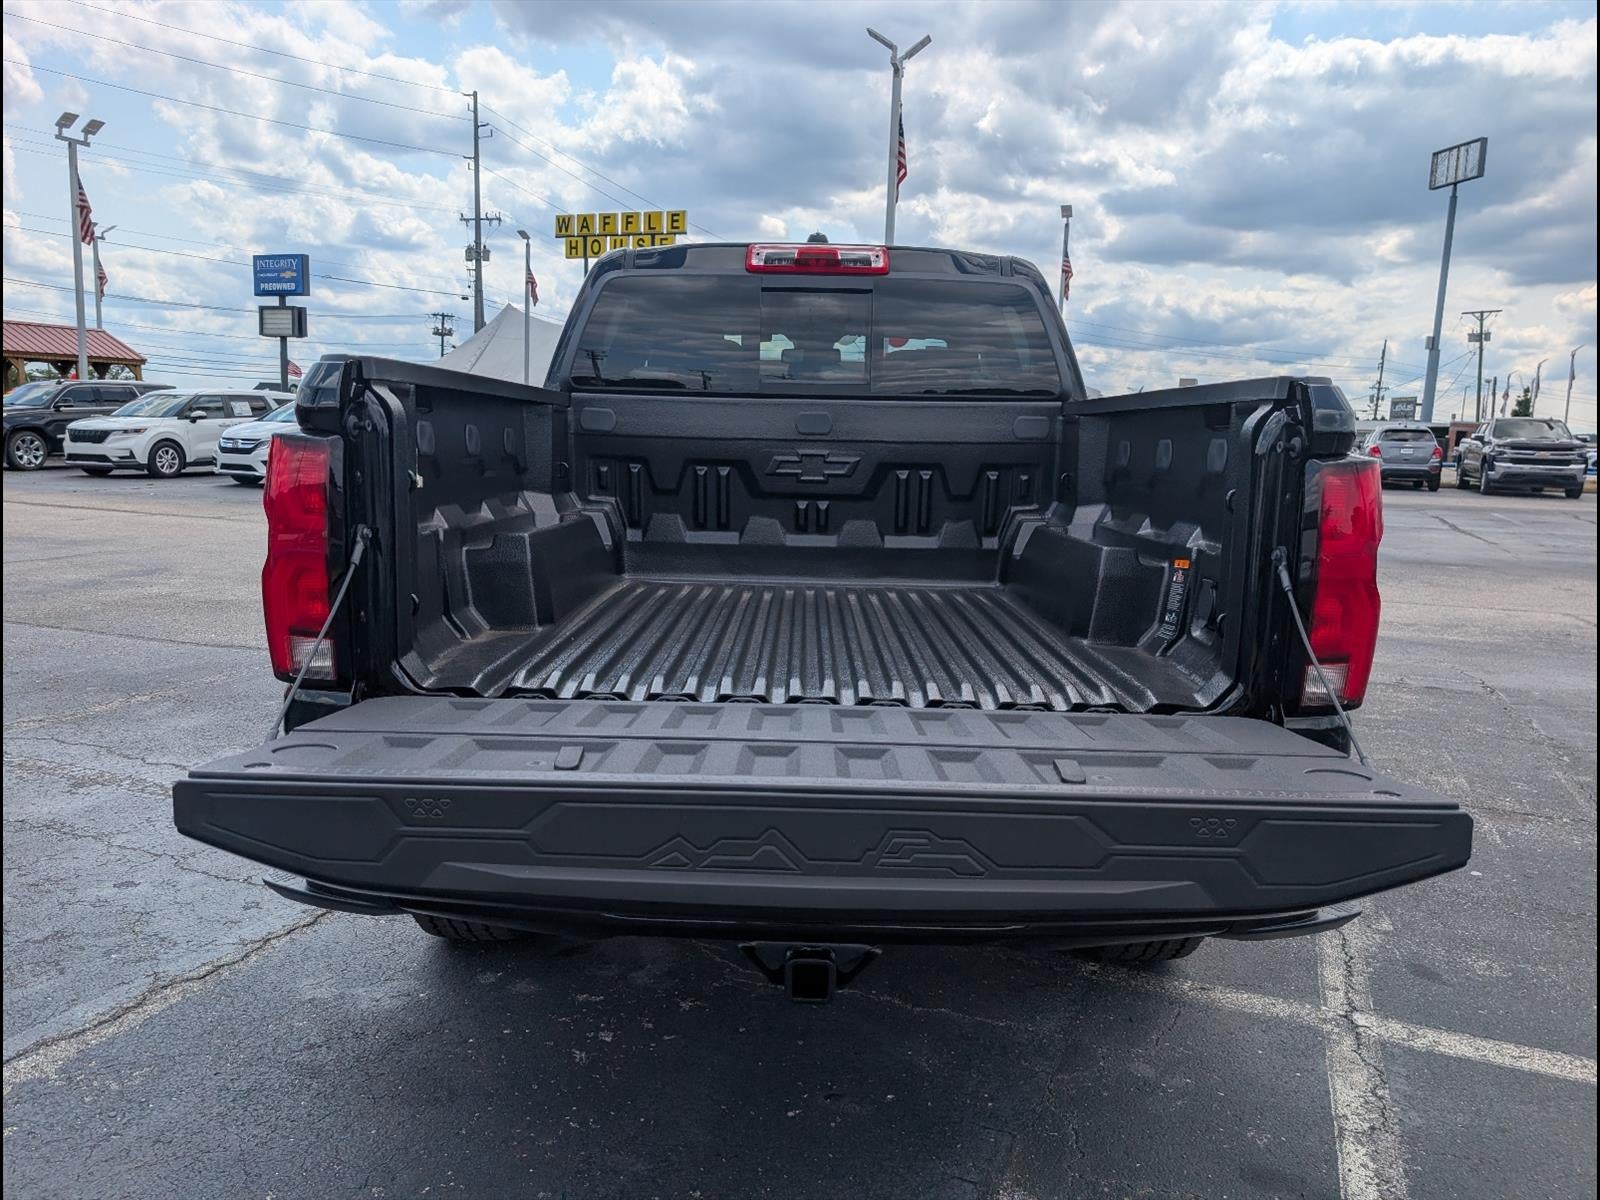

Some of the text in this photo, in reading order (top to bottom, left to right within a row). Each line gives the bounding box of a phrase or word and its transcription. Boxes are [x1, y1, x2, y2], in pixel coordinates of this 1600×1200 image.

[557, 213, 680, 232] WAFFLE
[256, 258, 297, 270] INTEGRITY
[260, 282, 296, 291] PREOWNED
